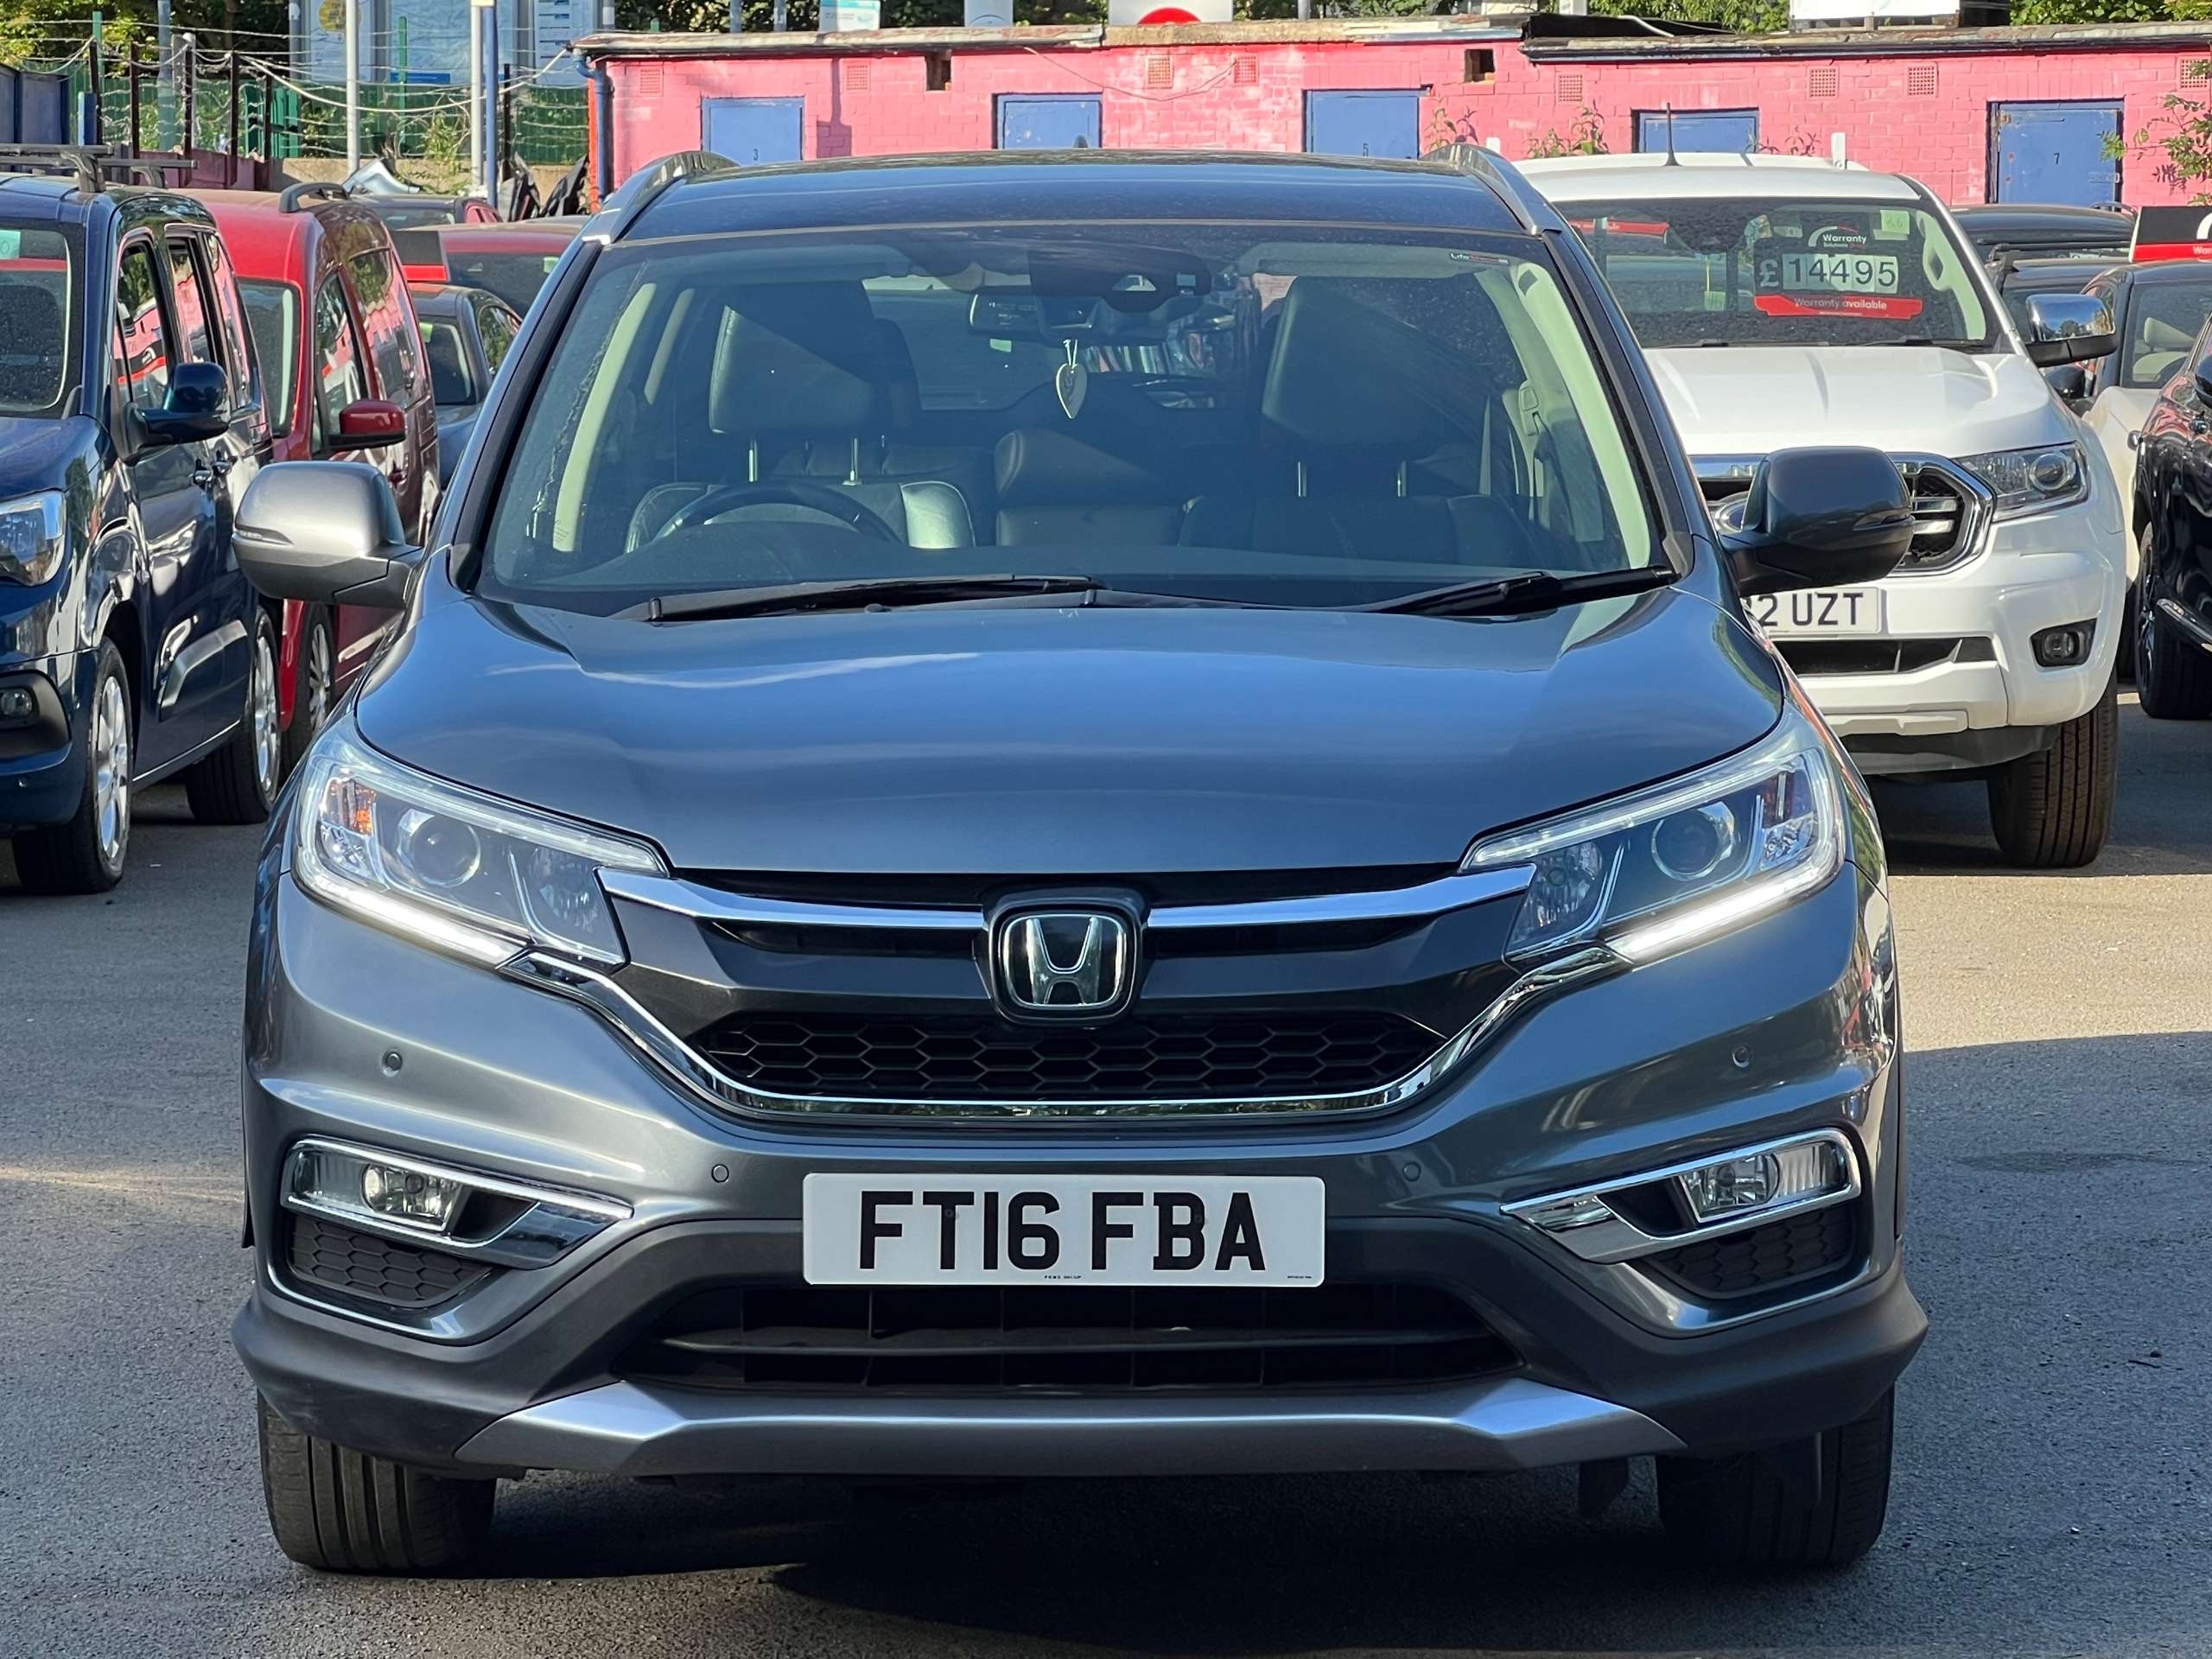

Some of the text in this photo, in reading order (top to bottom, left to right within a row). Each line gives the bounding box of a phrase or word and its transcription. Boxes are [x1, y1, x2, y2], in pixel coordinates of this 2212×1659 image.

[2053, 152, 2060, 165] 7
[1822, 234, 1866, 244] Warranty
[1795, 297, 1887, 309] Warranty available
[1745, 593, 1864, 626] 2 UZT
[859, 1191, 1266, 1271] FT16 FBA
